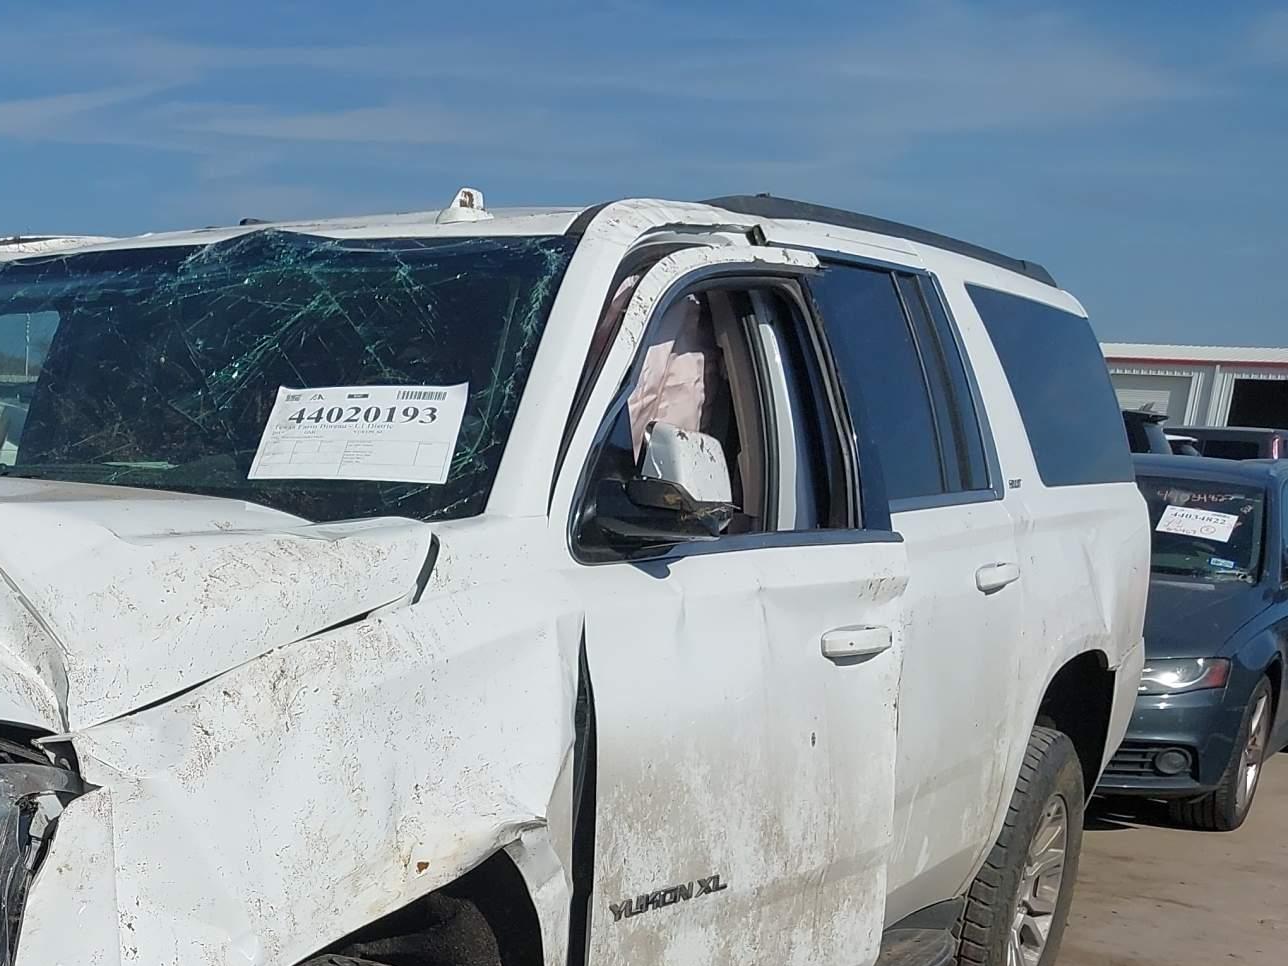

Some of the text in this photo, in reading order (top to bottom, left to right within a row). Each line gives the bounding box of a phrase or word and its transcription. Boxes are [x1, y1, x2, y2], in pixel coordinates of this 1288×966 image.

[288, 406, 439, 424] 44020193
[609, 874, 728, 922] YUKON XL
